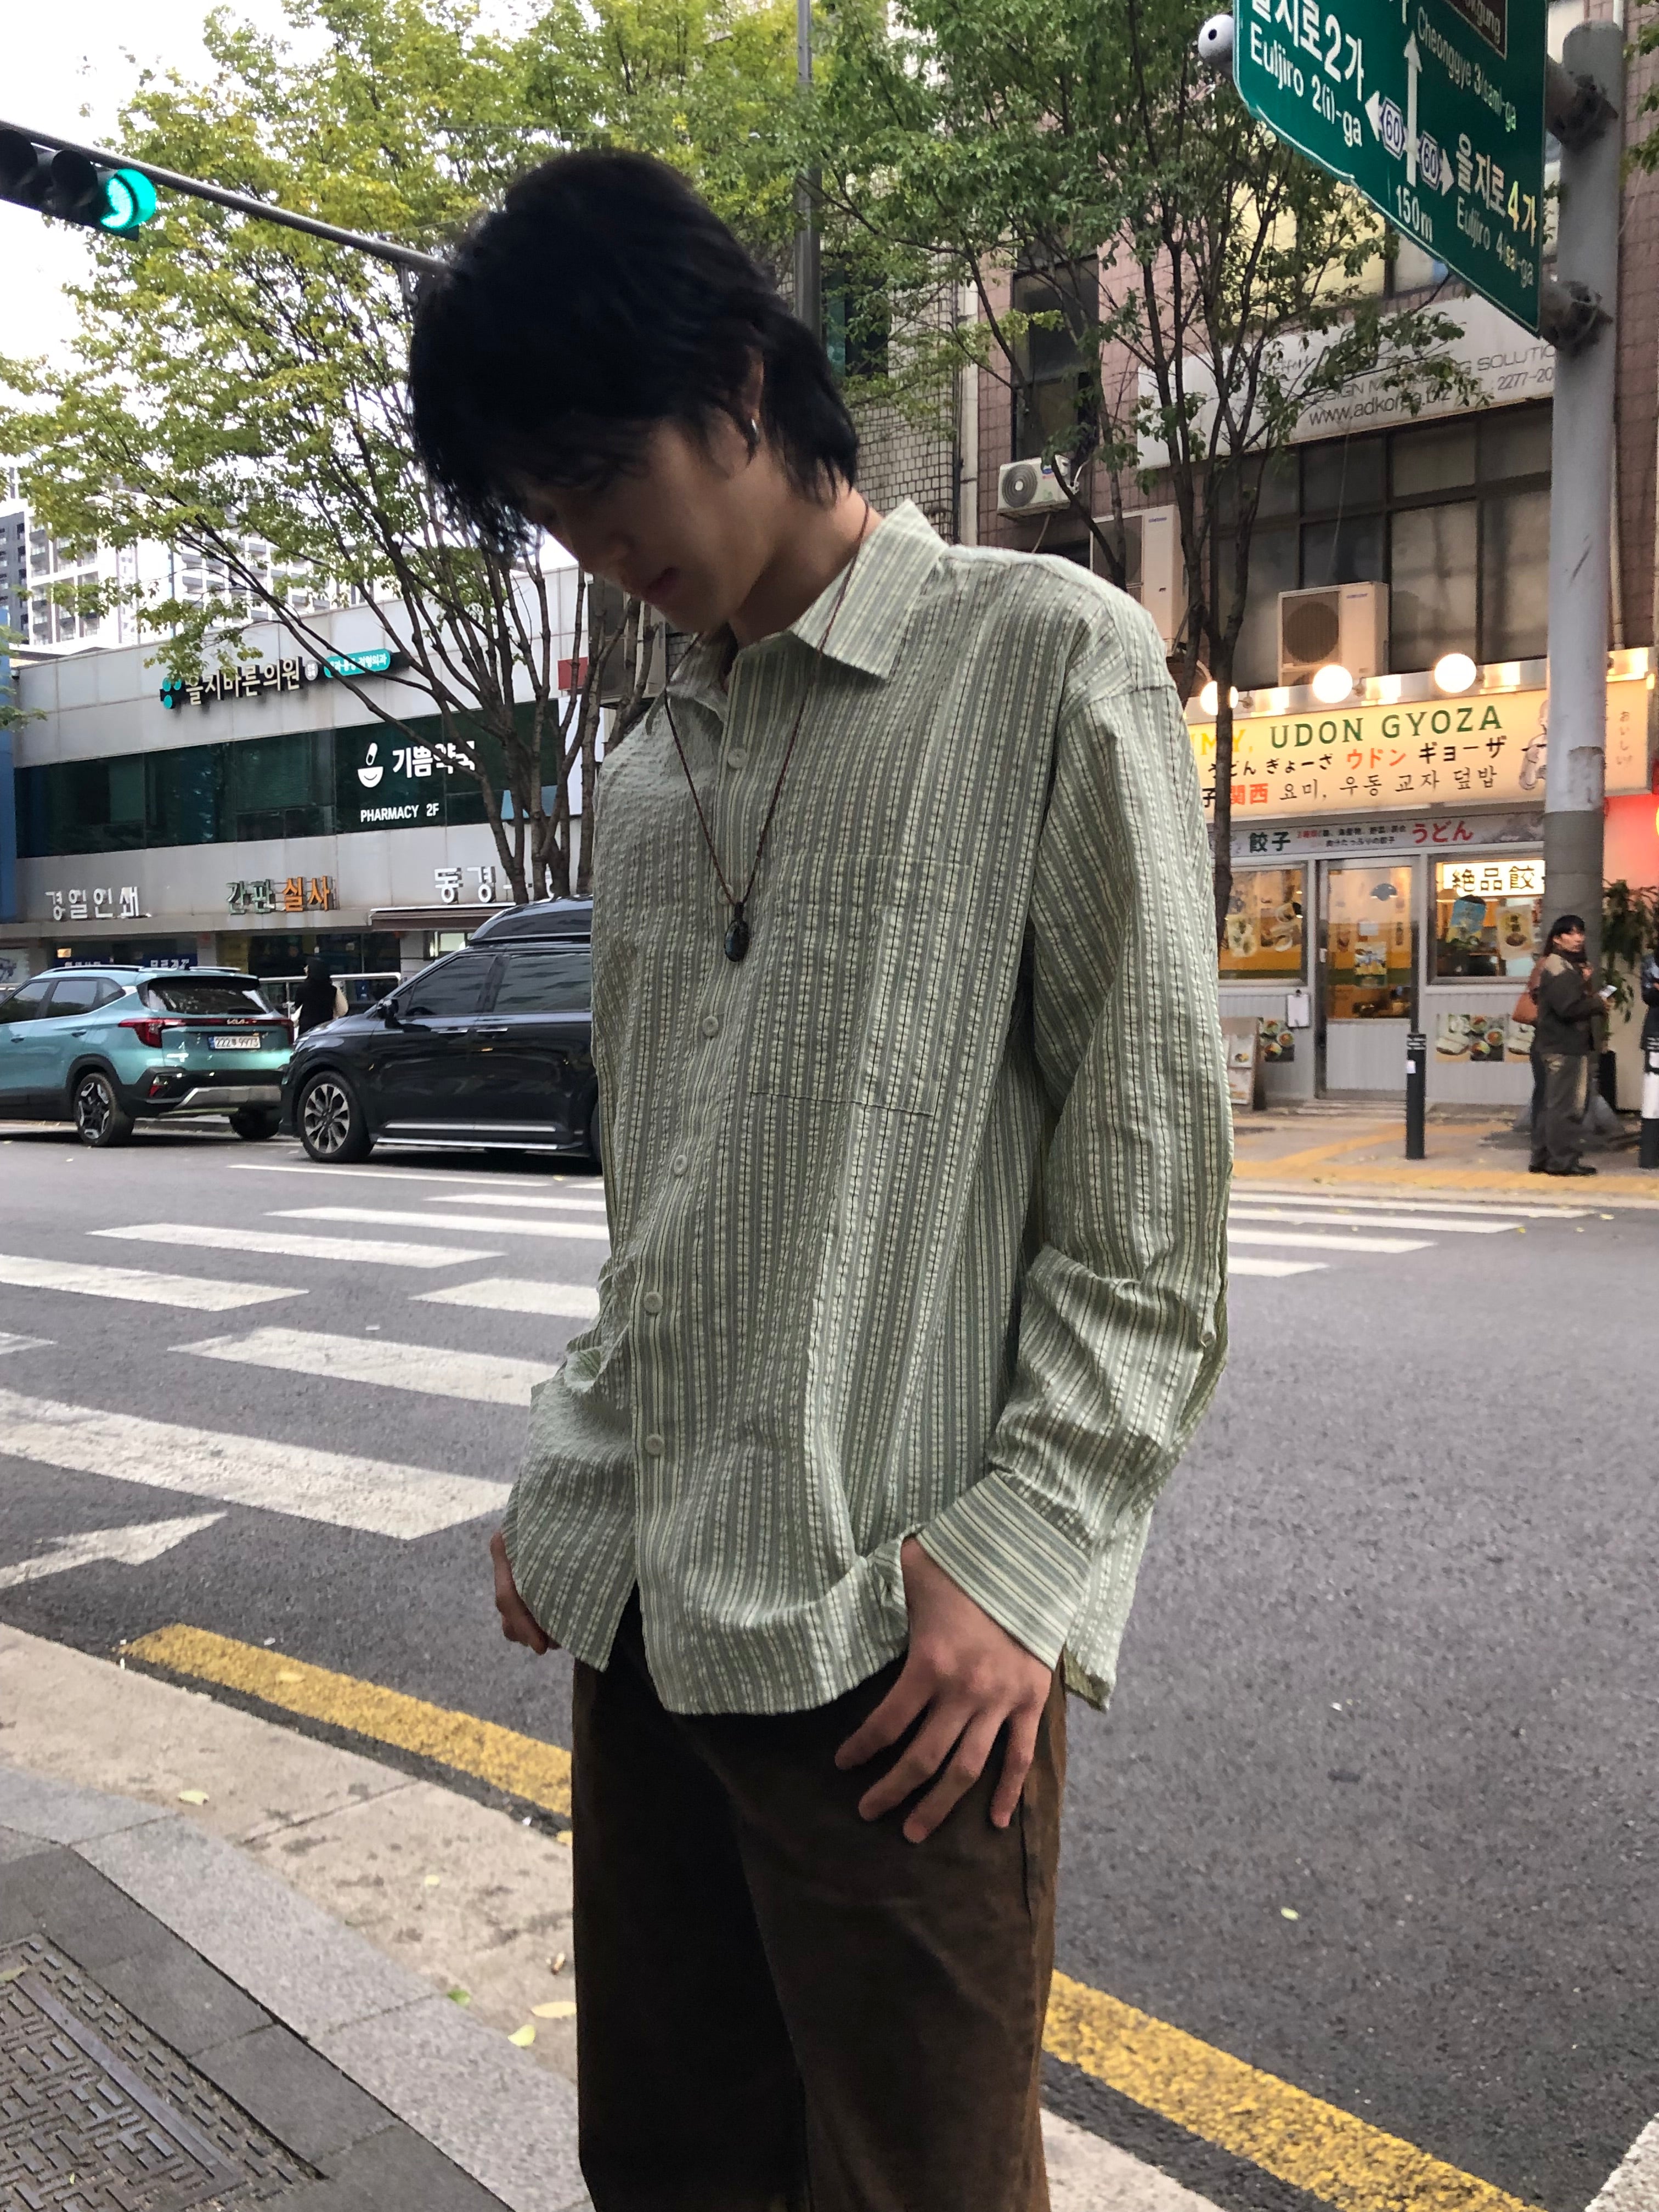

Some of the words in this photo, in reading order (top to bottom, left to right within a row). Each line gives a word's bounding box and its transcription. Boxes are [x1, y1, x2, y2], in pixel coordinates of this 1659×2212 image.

[1251, 21, 1304, 97] Euljiro
[1312, 75, 1362, 147] 2(i)-ga
[1386, 110, 1400, 147] 60
[1423, 143, 1436, 179] 60
[1457, 133, 1537, 247] 을지로4가
[1396, 185, 1433, 242] 150m
[1477, 344, 1556, 371] SOLUTIO
[1497, 366, 1554, 391] 2277-20
[1270, 718, 1364, 749] UDON
[1381, 705, 1503, 738] GYOZA
[1347, 747, 1407, 770] ウドン
[1419, 735, 1507, 764] ギョーザ
[1279, 778, 1327, 801] 요미,
[1339, 774, 1383, 796] 우동
[1395, 769, 1440, 792] 교자
[1454, 765, 1497, 790] 덮밥
[360, 804, 419, 822] PHARMACY
[426, 803, 439, 816] 2F
[1249, 831, 1291, 853] 餃子
[1412, 820, 1474, 843] うどん
[282, 876, 332, 912] 실사
[1452, 865, 1545, 892] 絶品餃
[45, 886, 141, 921] 경일인쇄
